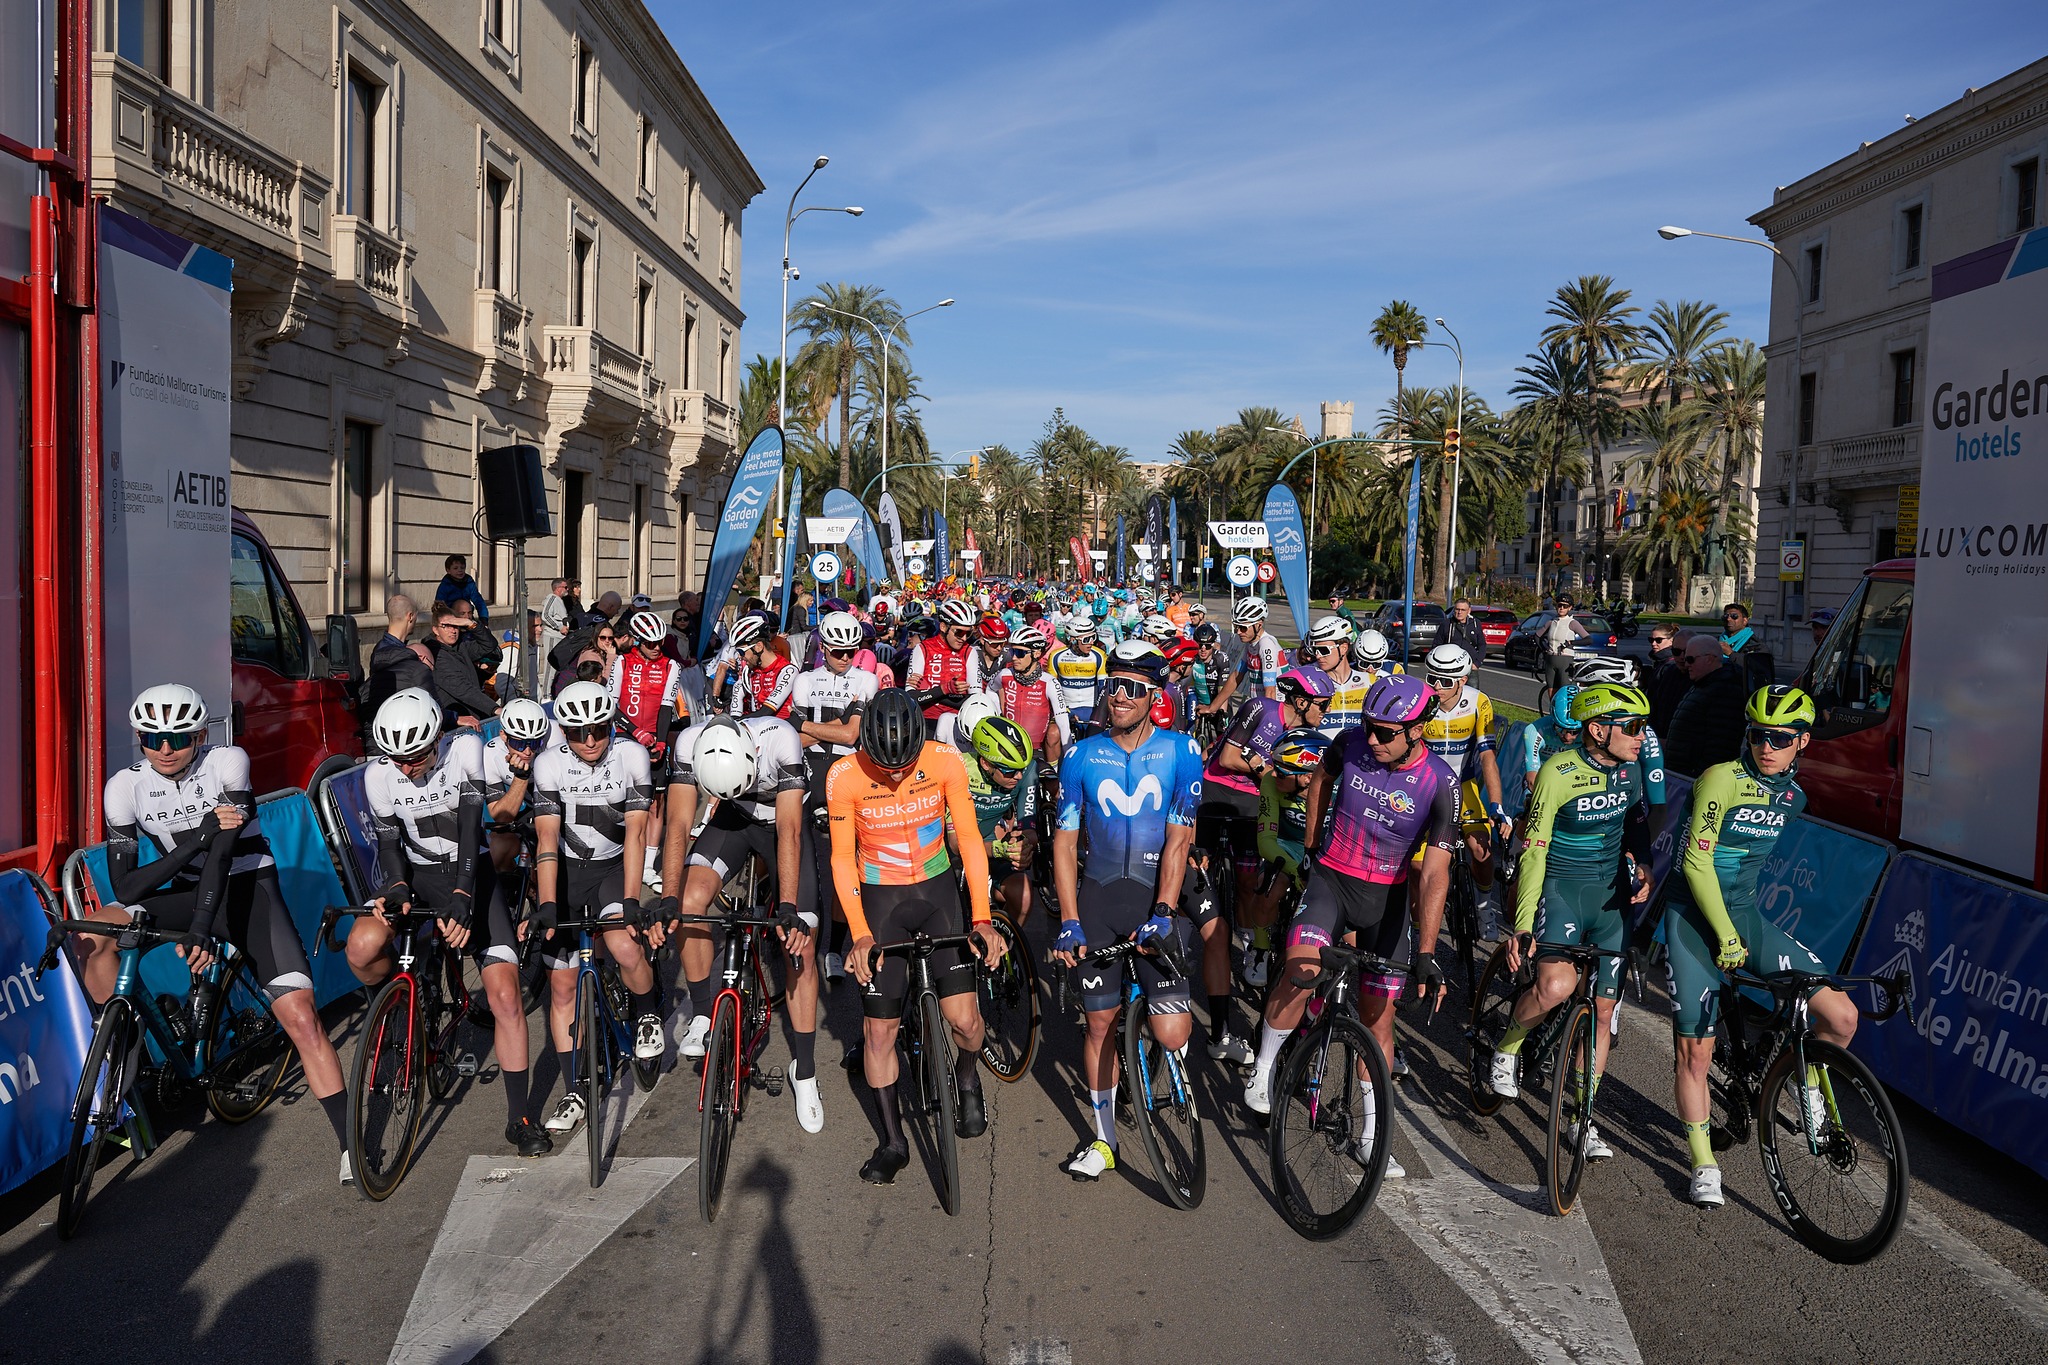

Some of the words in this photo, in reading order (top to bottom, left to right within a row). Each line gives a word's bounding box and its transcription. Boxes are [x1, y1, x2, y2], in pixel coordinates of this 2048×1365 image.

[129, 366, 165, 386] Fundació
[166, 375, 198, 395] Mallorca
[199, 383, 226, 402] Turisme
[130, 382, 157, 401] Consell
[159, 391, 169, 403] de
[170, 393, 199, 411] Mallorca
[1932, 369, 2048, 431] Garden
[1956, 426, 2021, 462] hotels
[747, 452, 761, 462] Live
[762, 449, 782, 459] more.
[744, 461, 759, 472] Feel
[759, 459, 780, 469] better.
[120, 480, 153, 492] CONSELLERIA
[174, 470, 227, 508] AETIB
[142, 495, 164, 505] CULTURA
[123, 504, 145, 514] ESPORTS
[176, 509, 196, 520] AGÈNCIA
[724, 506, 758, 523] Garden
[173, 520, 196, 531] TURÍSTICA
[197, 522, 208, 532] ILLES
[209, 524, 227, 533] BALEARS
[729, 520, 749, 531] hotels
[1217, 524, 1265, 535] Garden
[1228, 536, 1254, 544] hotels
[1919, 523, 2048, 558] LUXCOM
[818, 562, 833, 572] 25
[1146, 568, 1154, 576] 50
[1234, 566, 1250, 576] 25
[1966, 564, 2000, 576] Cycling
[2003, 564, 2046, 576] Holidays
[1264, 649, 1273, 670] solo
[770, 666, 795, 698] Cofidis
[1069, 679, 1095, 687] baloise
[626, 663, 642, 717] Cofidis
[917, 694, 933, 702] Cofidis
[1005, 680, 1018, 721] ofidis
[1584, 694, 1600, 703] BORA
[1577, 700, 1622, 720] SPECIALIZED
[1330, 716, 1362, 724] baloise
[1835, 714, 1864, 724] TRANSIT
[1089, 757, 1126, 769] CANYON
[1141, 752, 1164, 762] GOBIK
[1586, 756, 1602, 769] BORA
[1555, 760, 1576, 772] BORA
[559, 780, 623, 793] ARABAY
[826, 760, 853, 801] euskaltel
[149, 790, 167, 798] GOBIK
[393, 782, 460, 806] ARABAY
[862, 793, 895, 801] ORBEA
[1350, 774, 1415, 814] Burgos
[861, 790, 941, 819] euskaltel
[974, 802, 1009, 810] nsgrohe
[1024, 785, 1036, 817] BORA
[1576, 791, 1628, 812] BORA
[1286, 810, 1306, 822] BO
[1363, 807, 1395, 828] BH
[1699, 800, 1718, 835] XBO
[1734, 808, 1785, 827] BORA
[874, 821, 905, 829] GRUPO
[1730, 821, 1779, 838] hansgrohe
[1673, 816, 1693, 873] hansgrohe
[990, 918, 1014, 939] oval
[1917, 998, 1952, 1046] de
[1952, 1016, 2048, 1099] Palma
[1852, 1077, 1893, 1161] roval
[1762, 1142, 1800, 1221] roval
